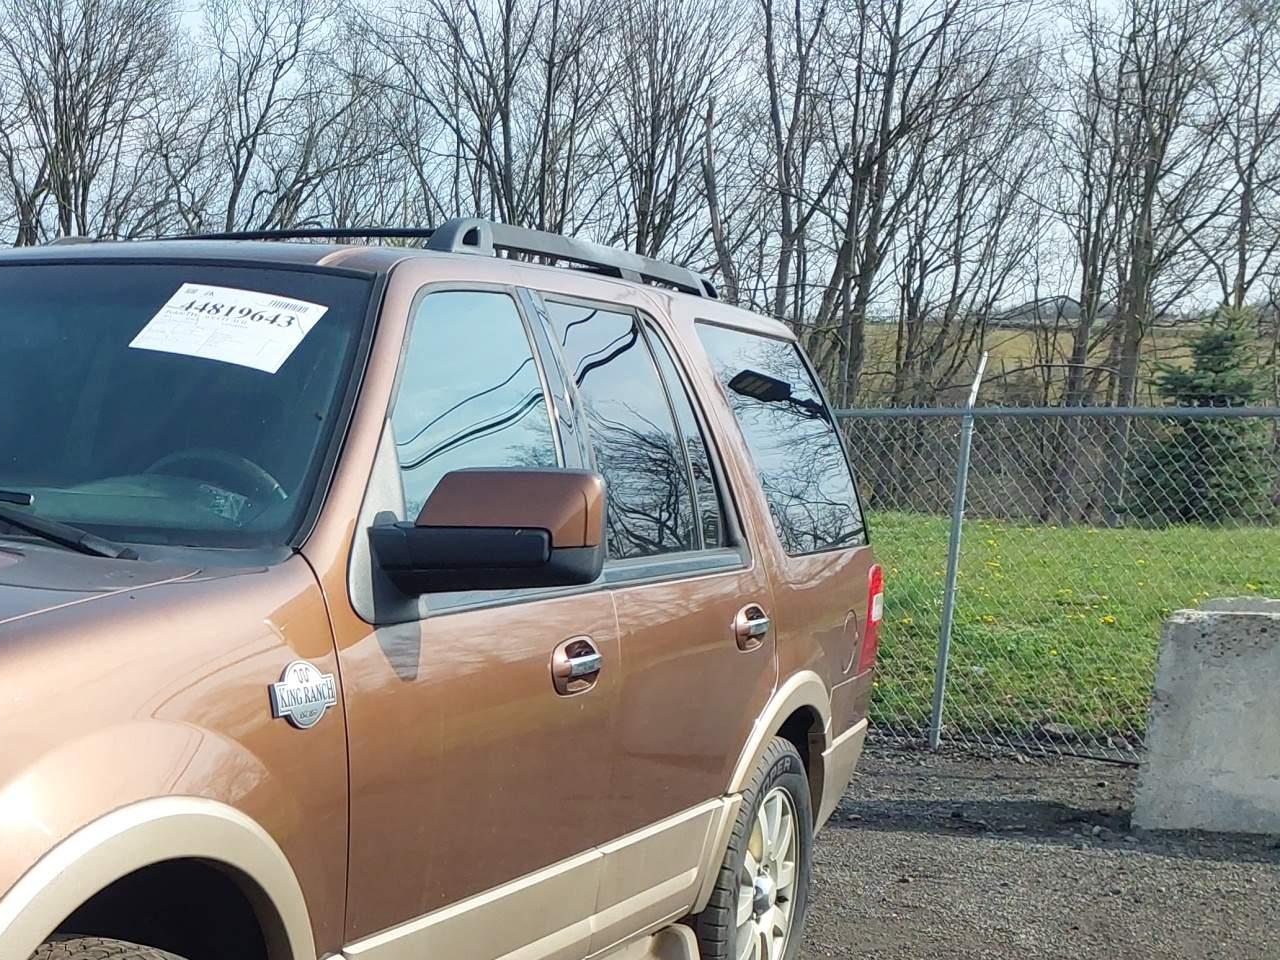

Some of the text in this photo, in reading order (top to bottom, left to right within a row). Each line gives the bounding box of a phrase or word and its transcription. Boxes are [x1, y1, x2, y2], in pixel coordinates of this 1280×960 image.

[180, 299, 296, 328] 44819643
[278, 679, 335, 709] KING RANCH
